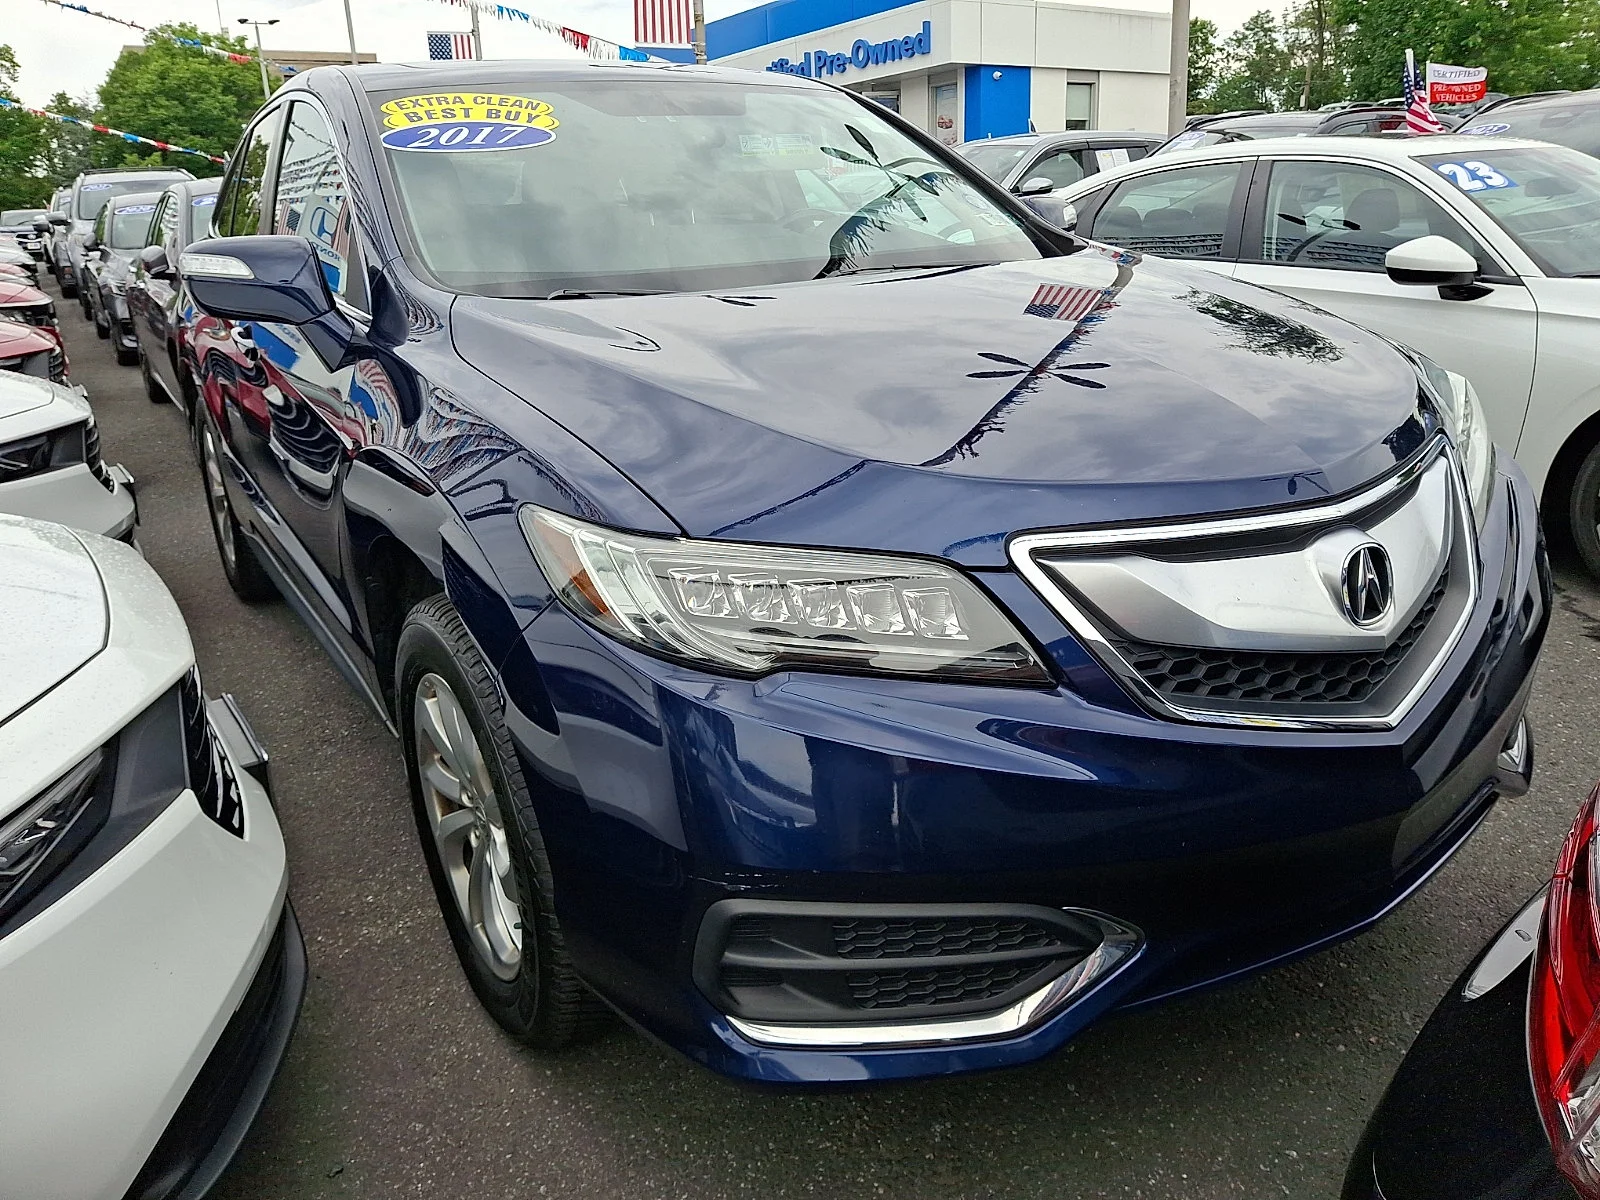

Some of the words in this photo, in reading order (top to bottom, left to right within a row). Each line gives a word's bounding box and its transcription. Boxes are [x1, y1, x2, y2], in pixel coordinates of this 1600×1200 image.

[815, 20, 931, 78] Pre-Owned
[1432, 69, 1481, 79] CERTIFIED
[1433, 83, 1482, 93] PRE-OWNED
[394, 95, 465, 111] EXTRA
[473, 95, 541, 111] CLEAN
[1435, 93, 1478, 102] VEHICLES
[404, 107, 472, 123] BEST
[486, 108, 542, 124] BUY
[406, 126, 528, 148] 2017
[1437, 161, 1509, 192] 23
